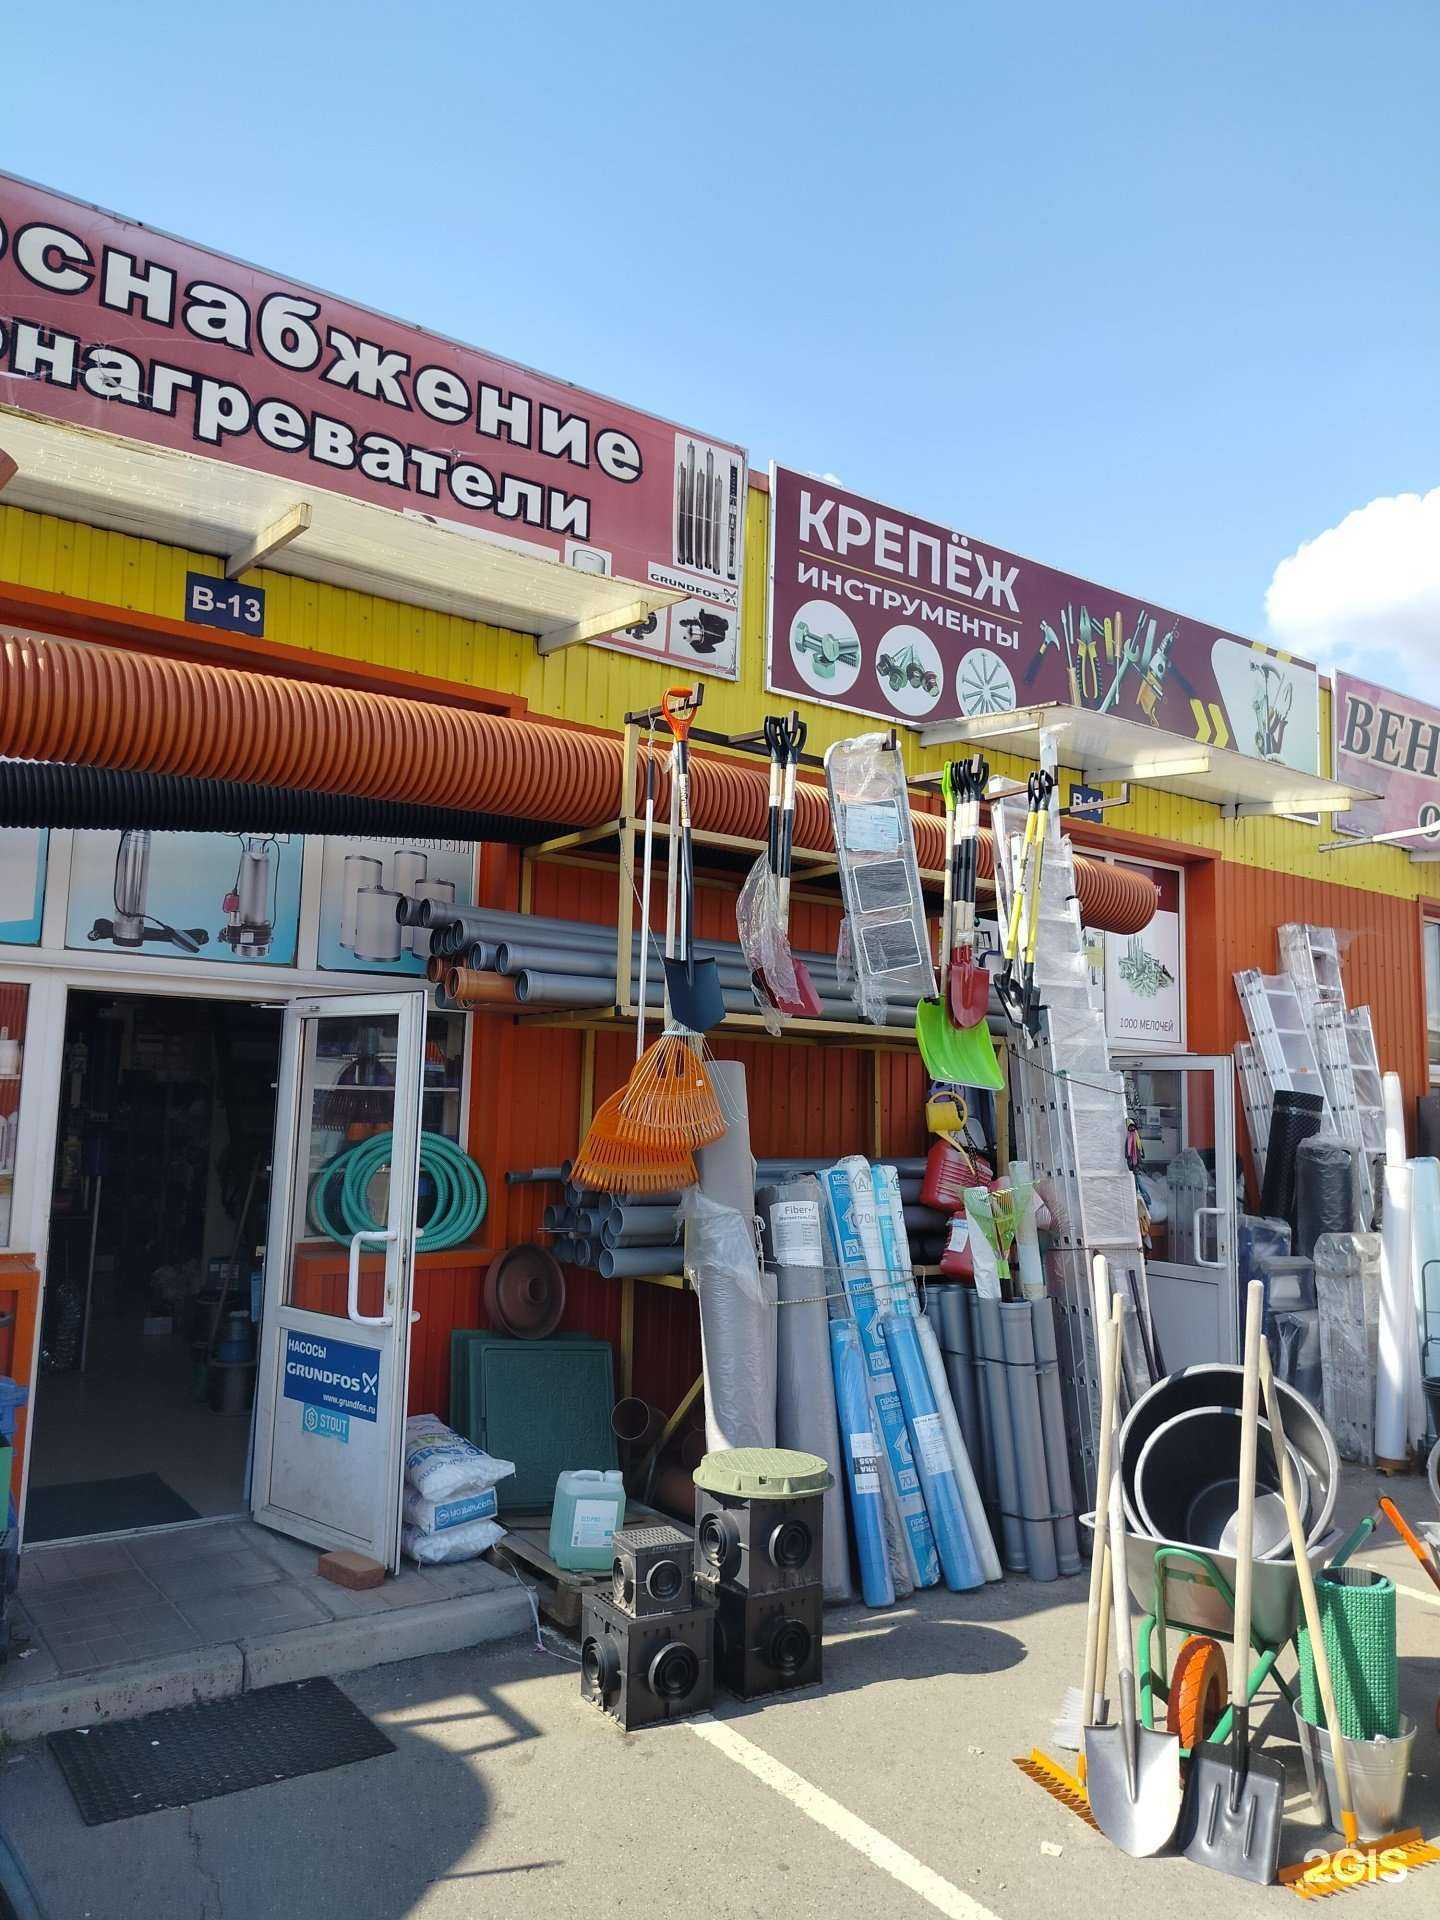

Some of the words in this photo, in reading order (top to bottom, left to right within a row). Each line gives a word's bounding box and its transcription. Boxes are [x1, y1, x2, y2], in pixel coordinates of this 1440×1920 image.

[799, 490, 1020, 613] КРЕПЁЖ
[651, 574, 720, 600] GRUNDFOS
[797, 561, 1020, 651] ИНСТРУМЕНТЫ
[1120, 1017, 1138, 1030] 1000
[1139, 1018, 1174, 1032] МЕЛОЧЕЙ
[288, 1338, 326, 1359] НАСОСЫ
[286, 1361, 360, 1392] GRUNDFOS
[323, 1393, 376, 1415] www.grundfos.ru
[320, 1413, 348, 1434] STOUT
